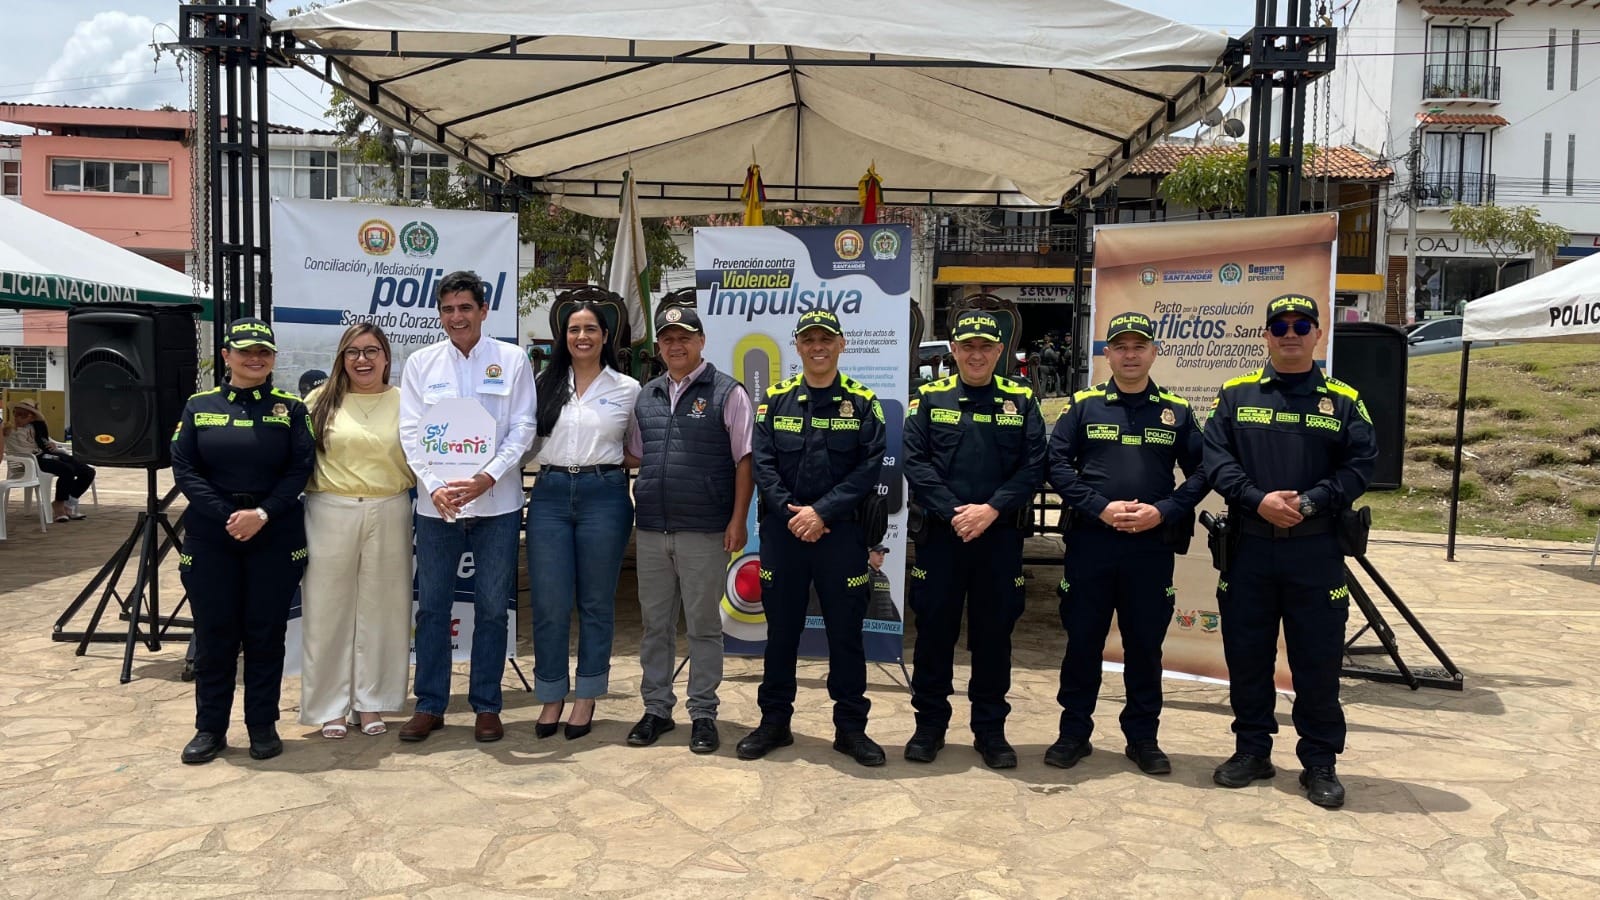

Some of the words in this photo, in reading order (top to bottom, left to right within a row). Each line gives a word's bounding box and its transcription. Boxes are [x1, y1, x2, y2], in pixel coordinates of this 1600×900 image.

[304, 256, 366, 273] Conciliación
[366, 267, 372, 277] y
[374, 261, 425, 276] Mediación
[713, 257, 764, 269] Prevención
[765, 258, 795, 268] contra
[0, 271, 50, 298] LICIA
[723, 270, 790, 288] Violencia
[369, 268, 507, 315] polial
[708, 282, 863, 322] Impulsiva
[1154, 301, 1182, 313] Pacto
[1198, 302, 1254, 315] resolución
[1271, 298, 1314, 311] POLICÍA
[341, 310, 397, 329] Sanando
[400, 313, 444, 329] Corazo
[800, 310, 837, 323] POLICÍA
[1111, 315, 1148, 328] POLICÍA
[1550, 302, 1600, 327] POLIC
[958, 316, 997, 328] POLICÍA
[1150, 313, 1227, 339] nflictos
[232, 323, 272, 336] POLICÍA
[385, 331, 435, 345] struyendo
[1157, 340, 1204, 357] Sanando
[1207, 340, 1265, 357] Corazones
[1176, 357, 1238, 370] Construyendo
[1148, 431, 1172, 440] POLICÍA
